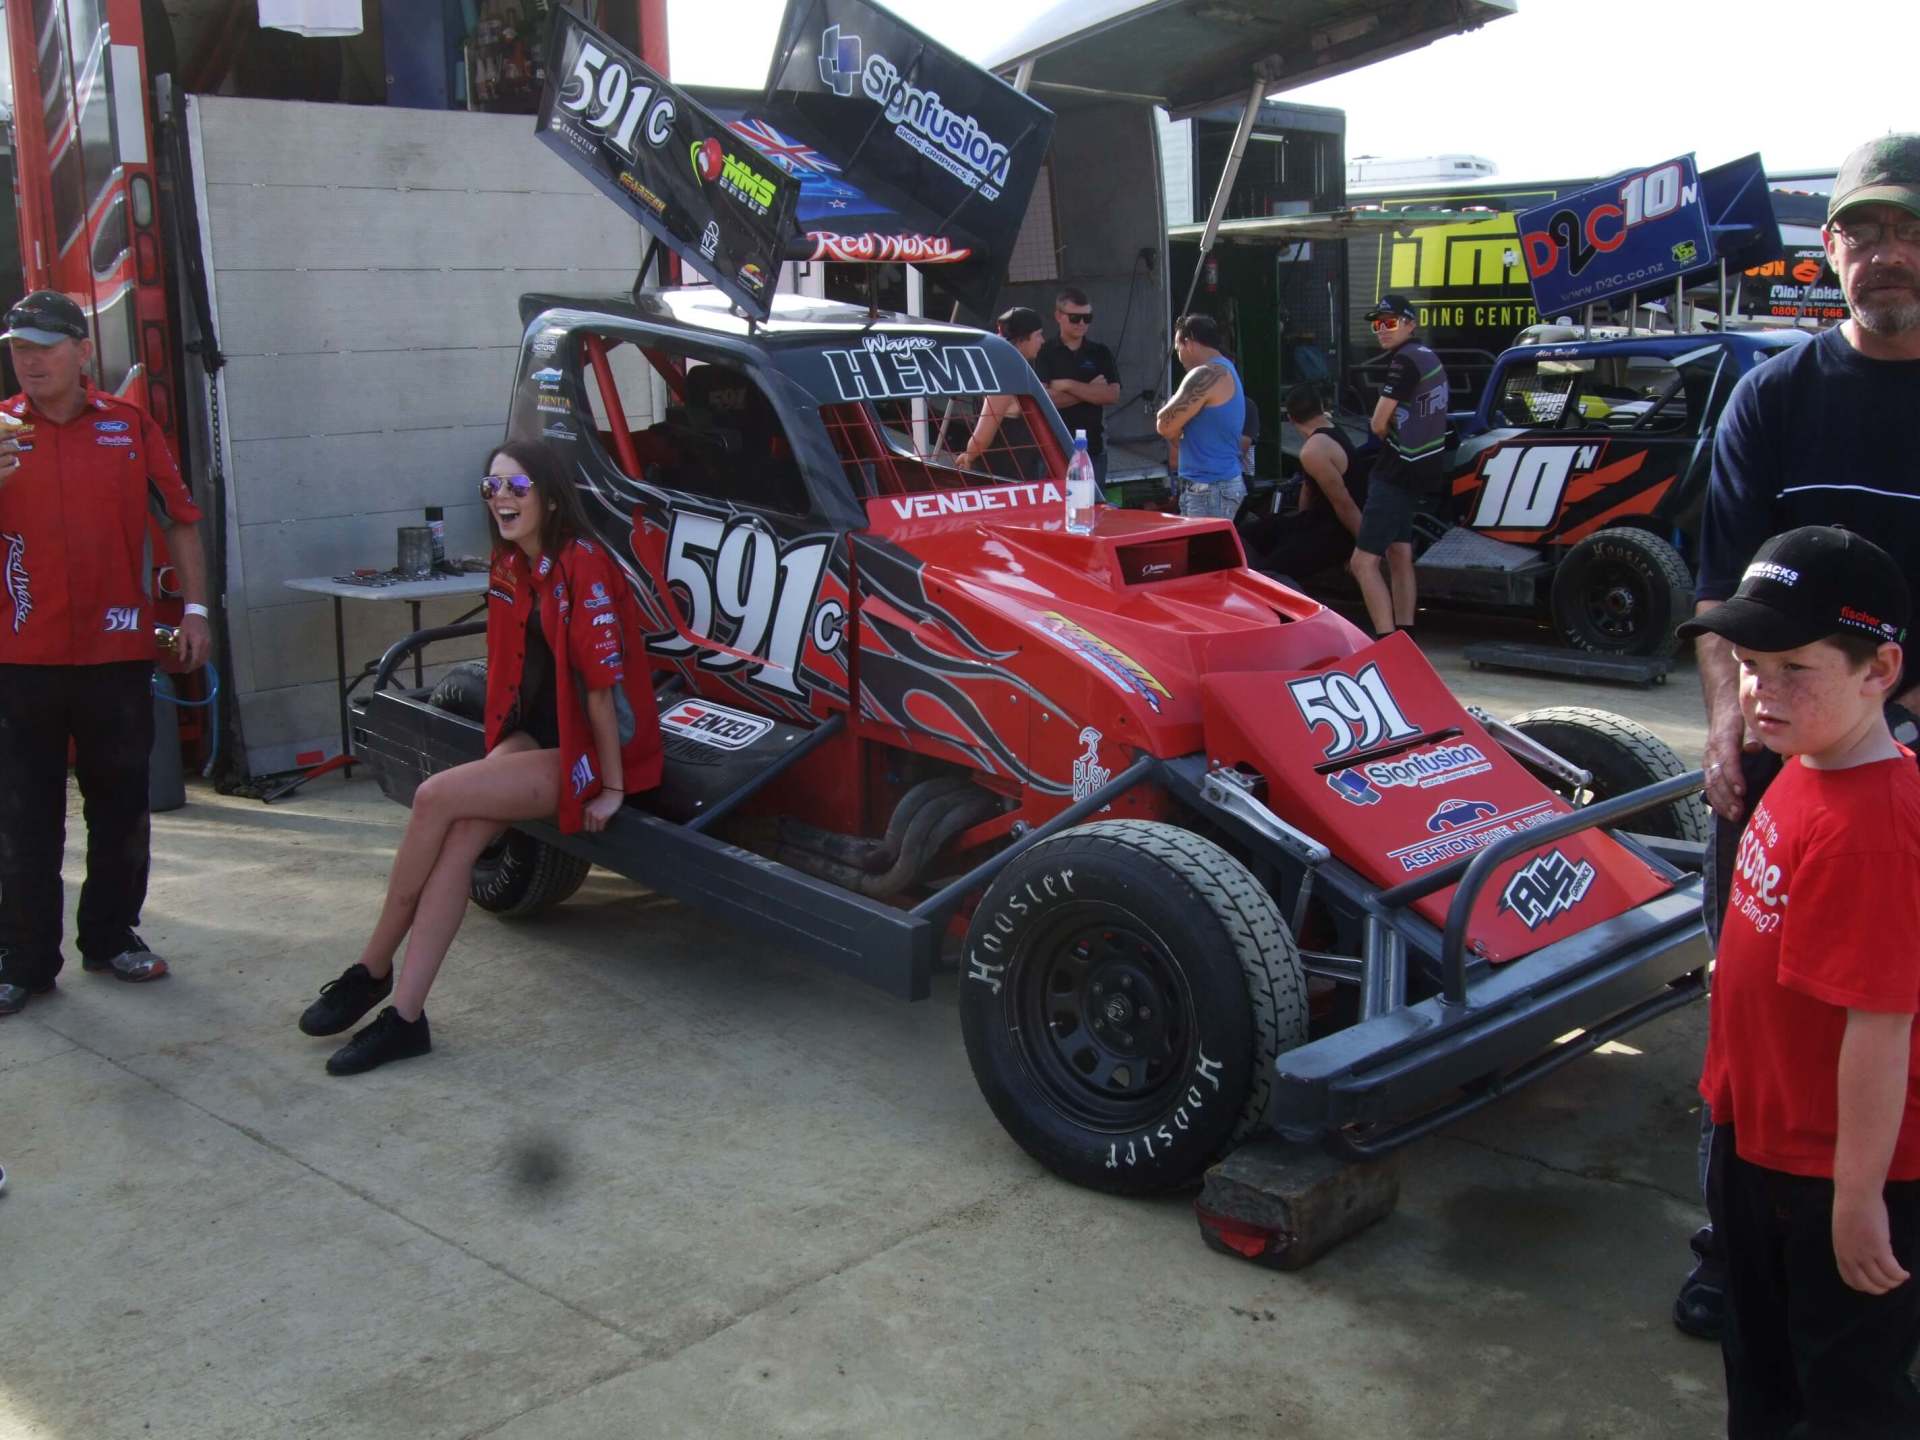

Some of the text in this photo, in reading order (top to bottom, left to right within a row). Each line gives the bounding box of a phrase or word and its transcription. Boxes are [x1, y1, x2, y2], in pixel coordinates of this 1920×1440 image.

[558, 38, 655, 160] 591
[863, 54, 1010, 187] Signfusion
[722, 152, 777, 208] MMS
[924, 139, 968, 183] GRAPHICS
[719, 177, 769, 217] GROUP
[1619, 161, 1683, 230] 10
[1523, 203, 1628, 279] D2C
[1420, 307, 1465, 326] DING
[862, 333, 936, 361] Wayne
[822, 346, 1001, 400] HEMI
[98, 422, 125, 432] Ford
[891, 482, 1064, 520] VENDETTA
[1472, 445, 1600, 527] 10 N
[103, 607, 140, 632] 591
[648, 506, 845, 698] 591 C
[1841, 605, 1880, 627] fischer
[688, 712, 758, 741] ENZED
[1287, 660, 1424, 760] 591
[1073, 760, 1111, 786] BUSY
[1364, 744, 1487, 788] Signfusion
[1400, 834, 1484, 873] ASHTON
[968, 868, 1076, 996] Hoosier
[1741, 895, 1780, 933] Bring?
